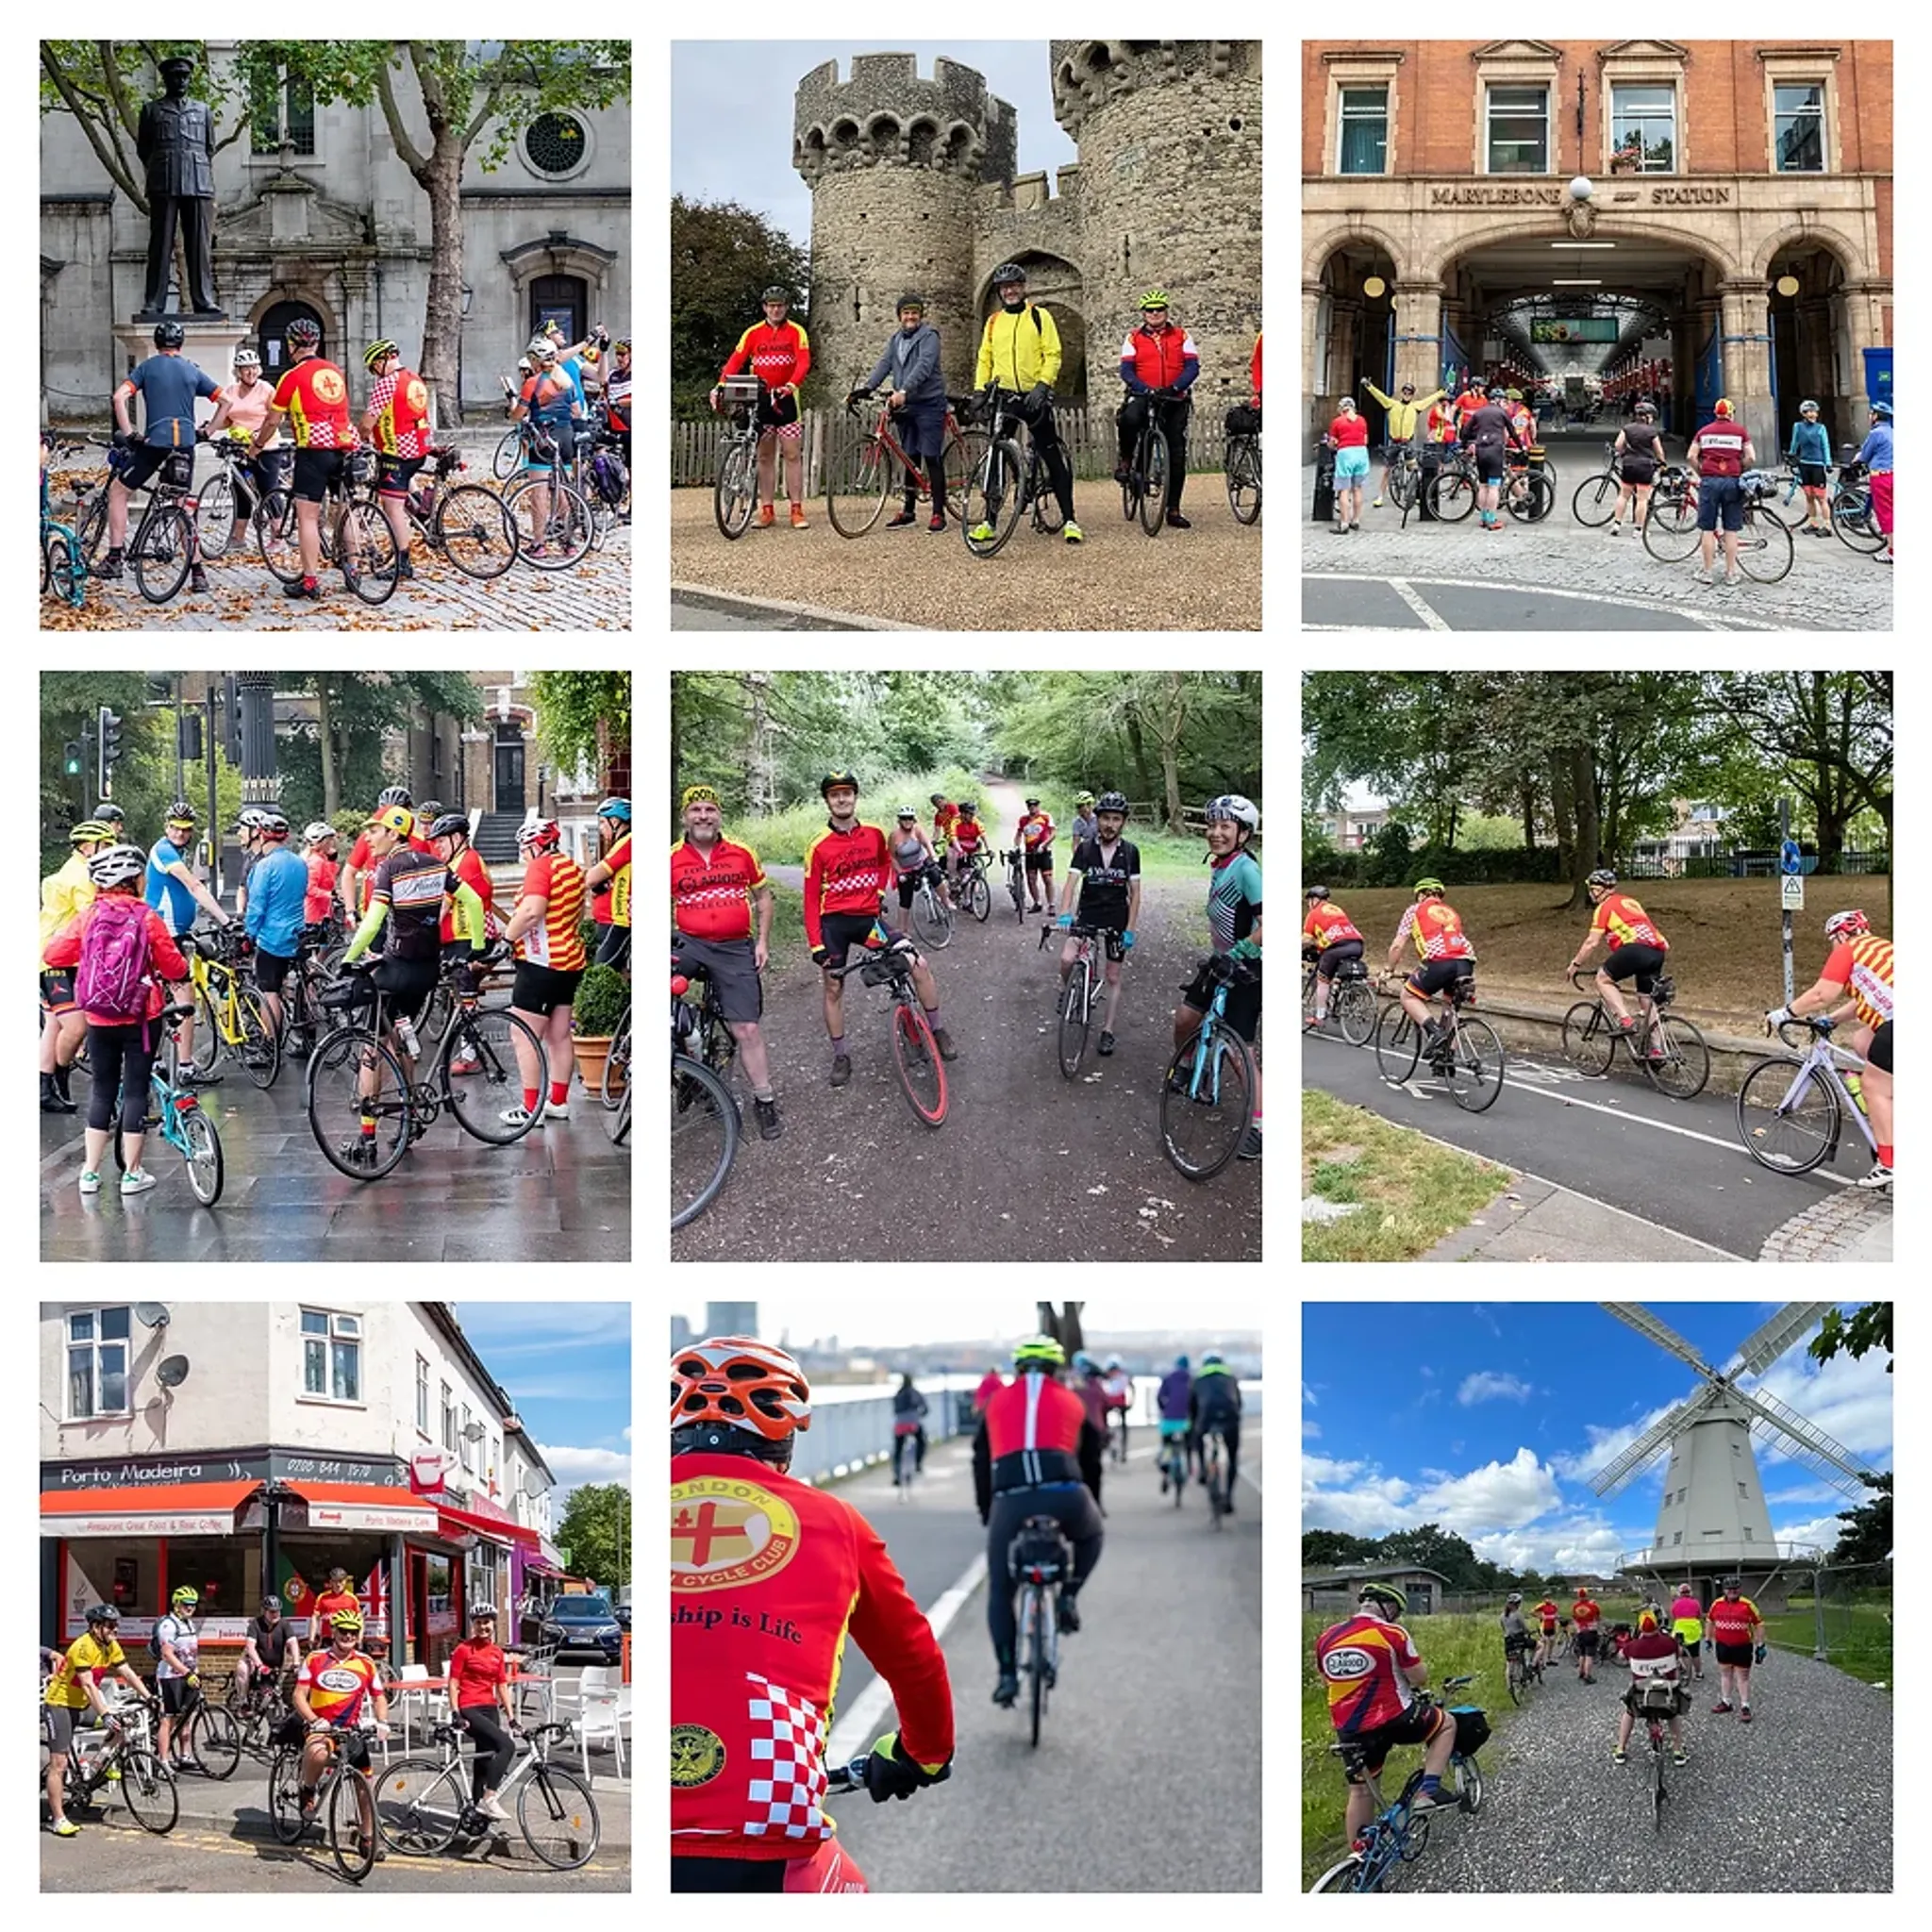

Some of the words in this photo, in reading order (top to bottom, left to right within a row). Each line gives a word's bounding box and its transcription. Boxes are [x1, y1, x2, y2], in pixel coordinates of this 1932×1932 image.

[1431, 189, 1561, 205] MARYLEBONE
[1652, 188, 1730, 204] STATION
[61, 1466, 111, 1483] Porto
[121, 1462, 201, 1480] Madeira
[683, 1566, 750, 1587] CYCLE
[752, 1539, 787, 1572] CLUB
[731, 1607, 752, 1628] is
[759, 1612, 802, 1644] Life
